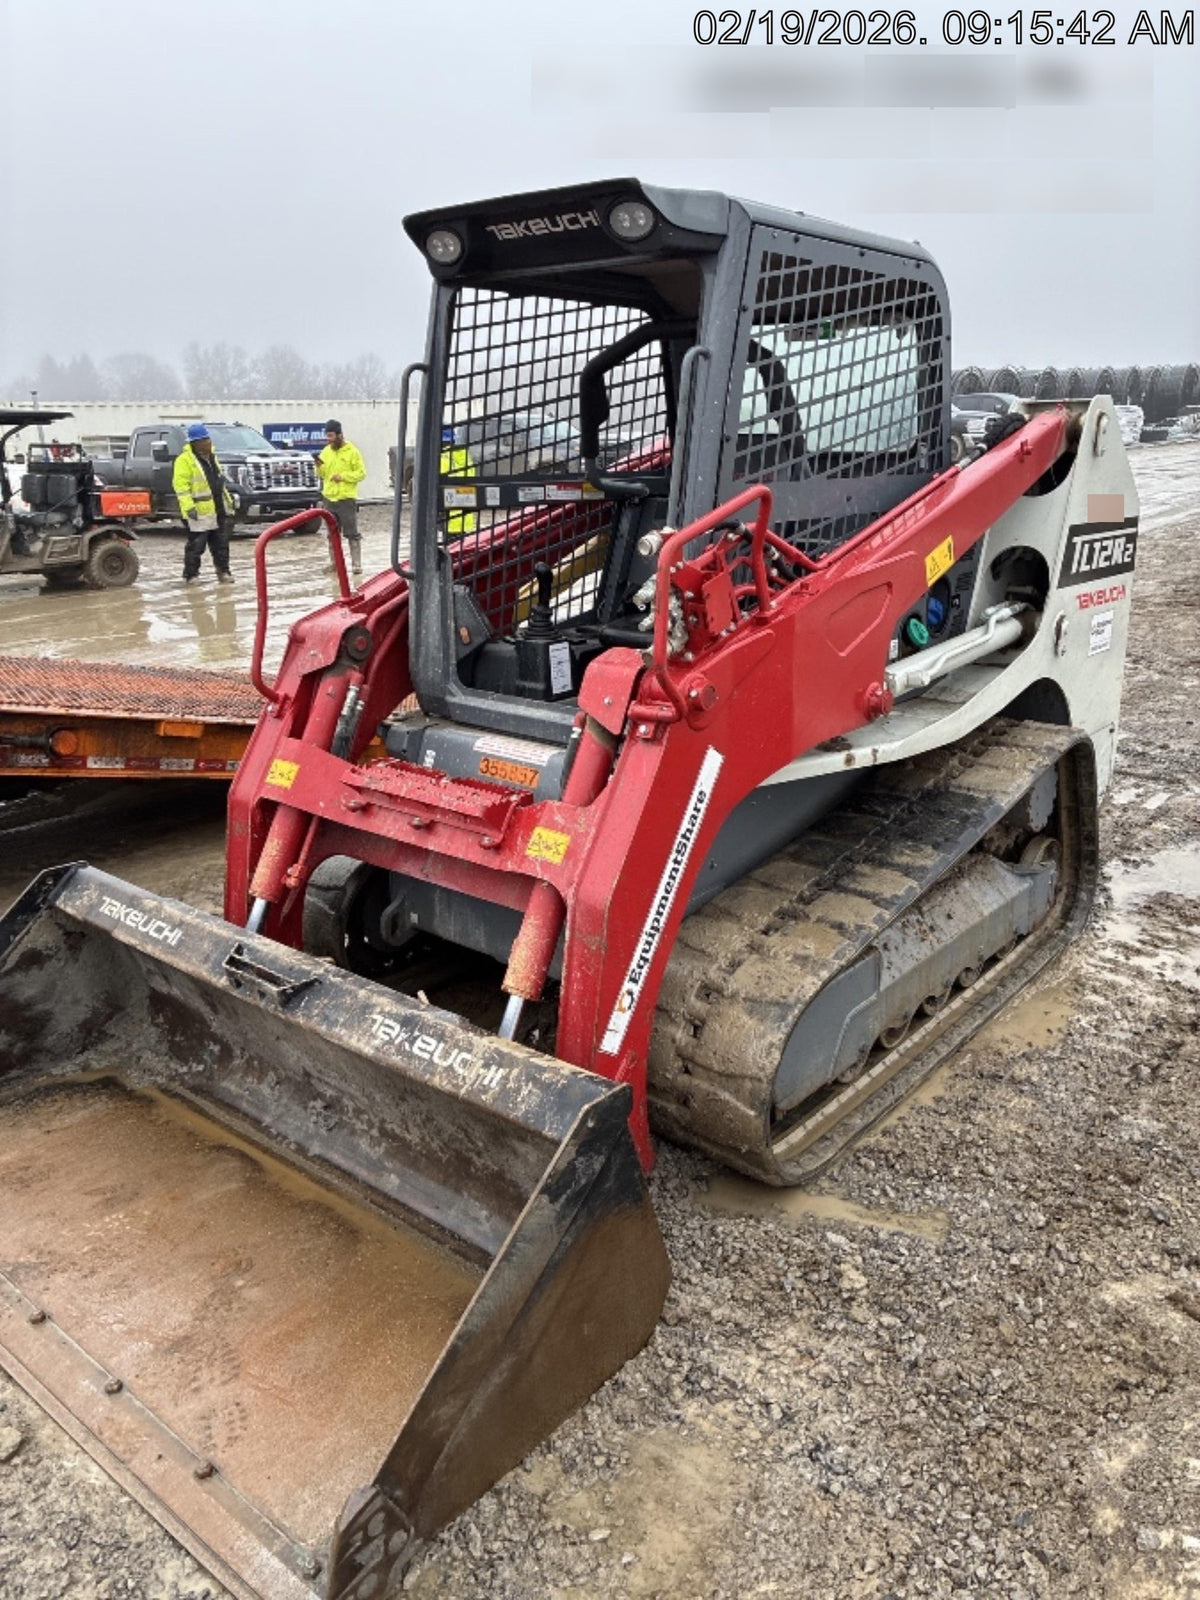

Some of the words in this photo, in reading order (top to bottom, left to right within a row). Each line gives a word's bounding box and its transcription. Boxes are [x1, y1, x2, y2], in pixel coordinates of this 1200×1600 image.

[484, 208, 601, 241] TAKEUCHI
[271, 426, 309, 441] mobile
[1076, 584, 1127, 611] TAKEUCHI
[628, 788, 707, 986] EquipmentShare
[98, 895, 184, 946] TAKEUCHI
